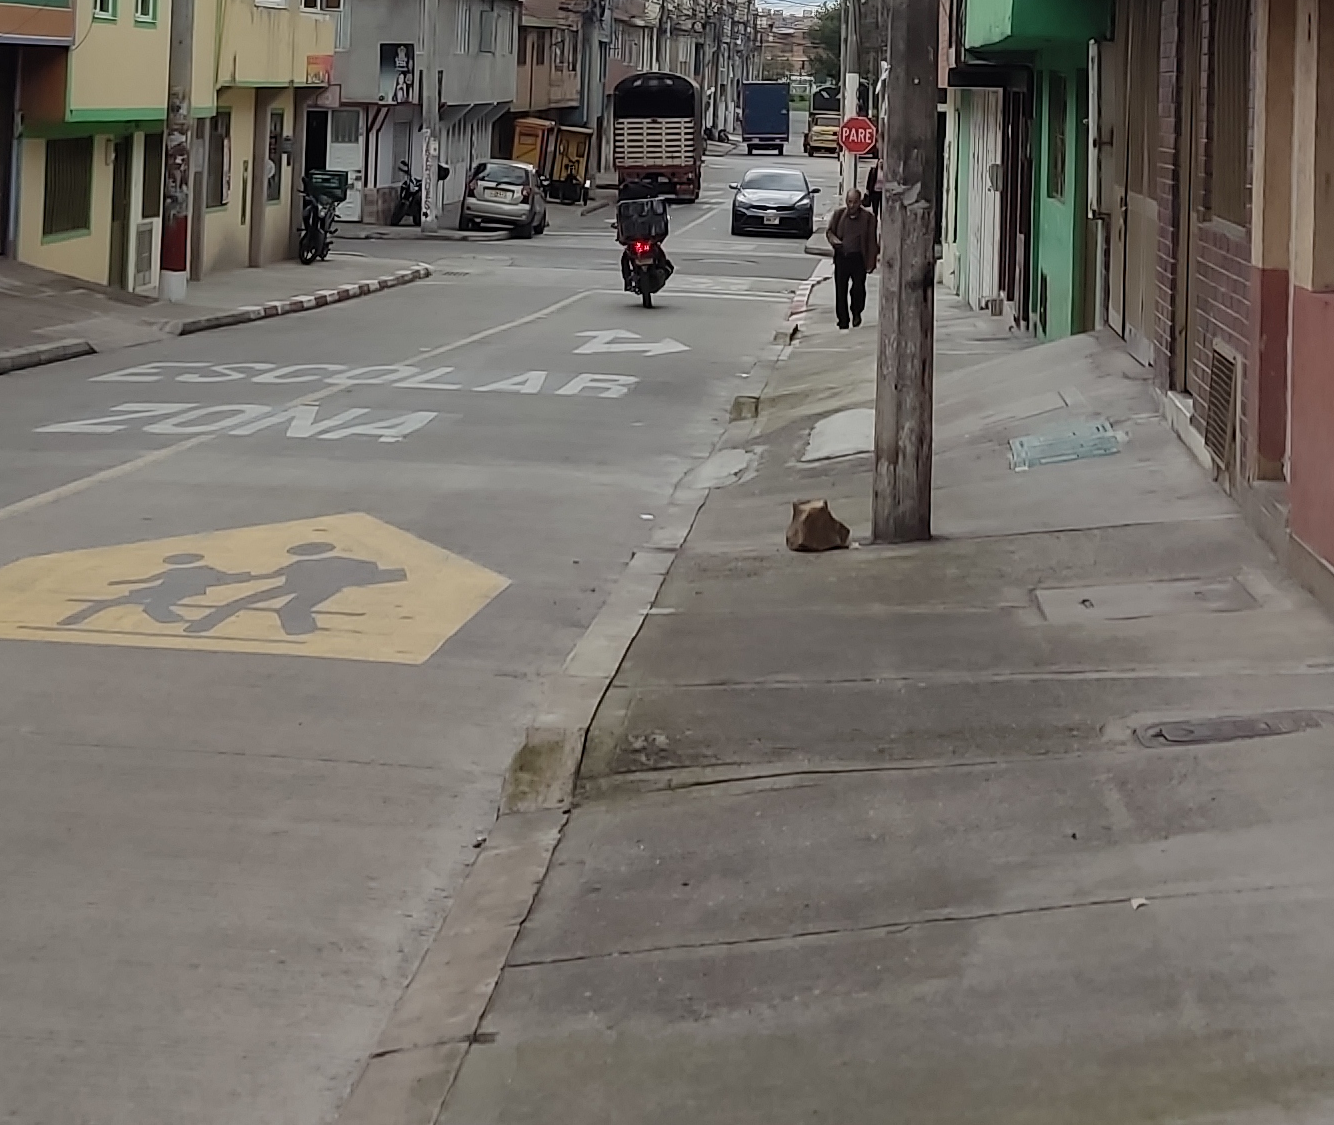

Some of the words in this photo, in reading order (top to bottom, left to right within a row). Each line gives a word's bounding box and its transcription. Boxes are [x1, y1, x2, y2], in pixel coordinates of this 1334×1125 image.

[842, 127, 873, 143] PARE
[88, 360, 640, 398] ESCOLAR
[33, 401, 439, 443] ZONA
